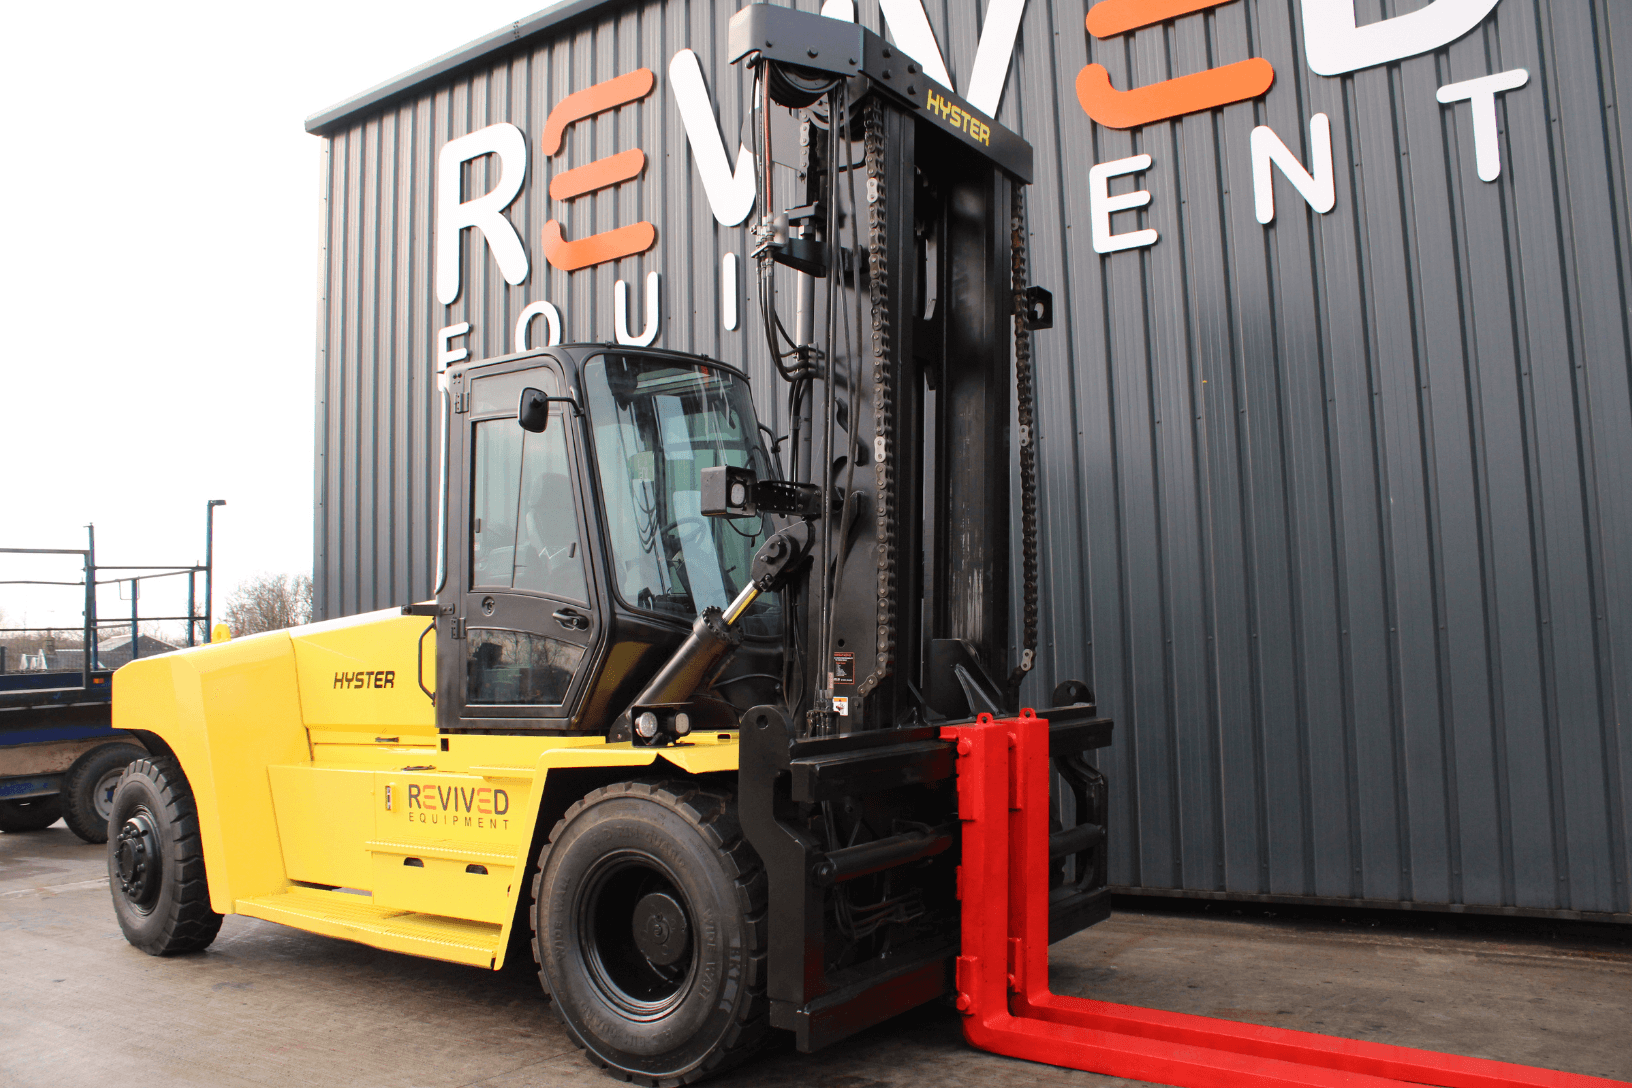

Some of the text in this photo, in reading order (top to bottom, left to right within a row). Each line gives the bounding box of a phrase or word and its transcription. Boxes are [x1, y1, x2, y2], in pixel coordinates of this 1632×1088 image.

[926, 88, 991, 147] HYSTER
[333, 670, 396, 690] HYSTER
[407, 783, 510, 816] REVIVED
[408, 811, 510, 831] EQUIPMENT
